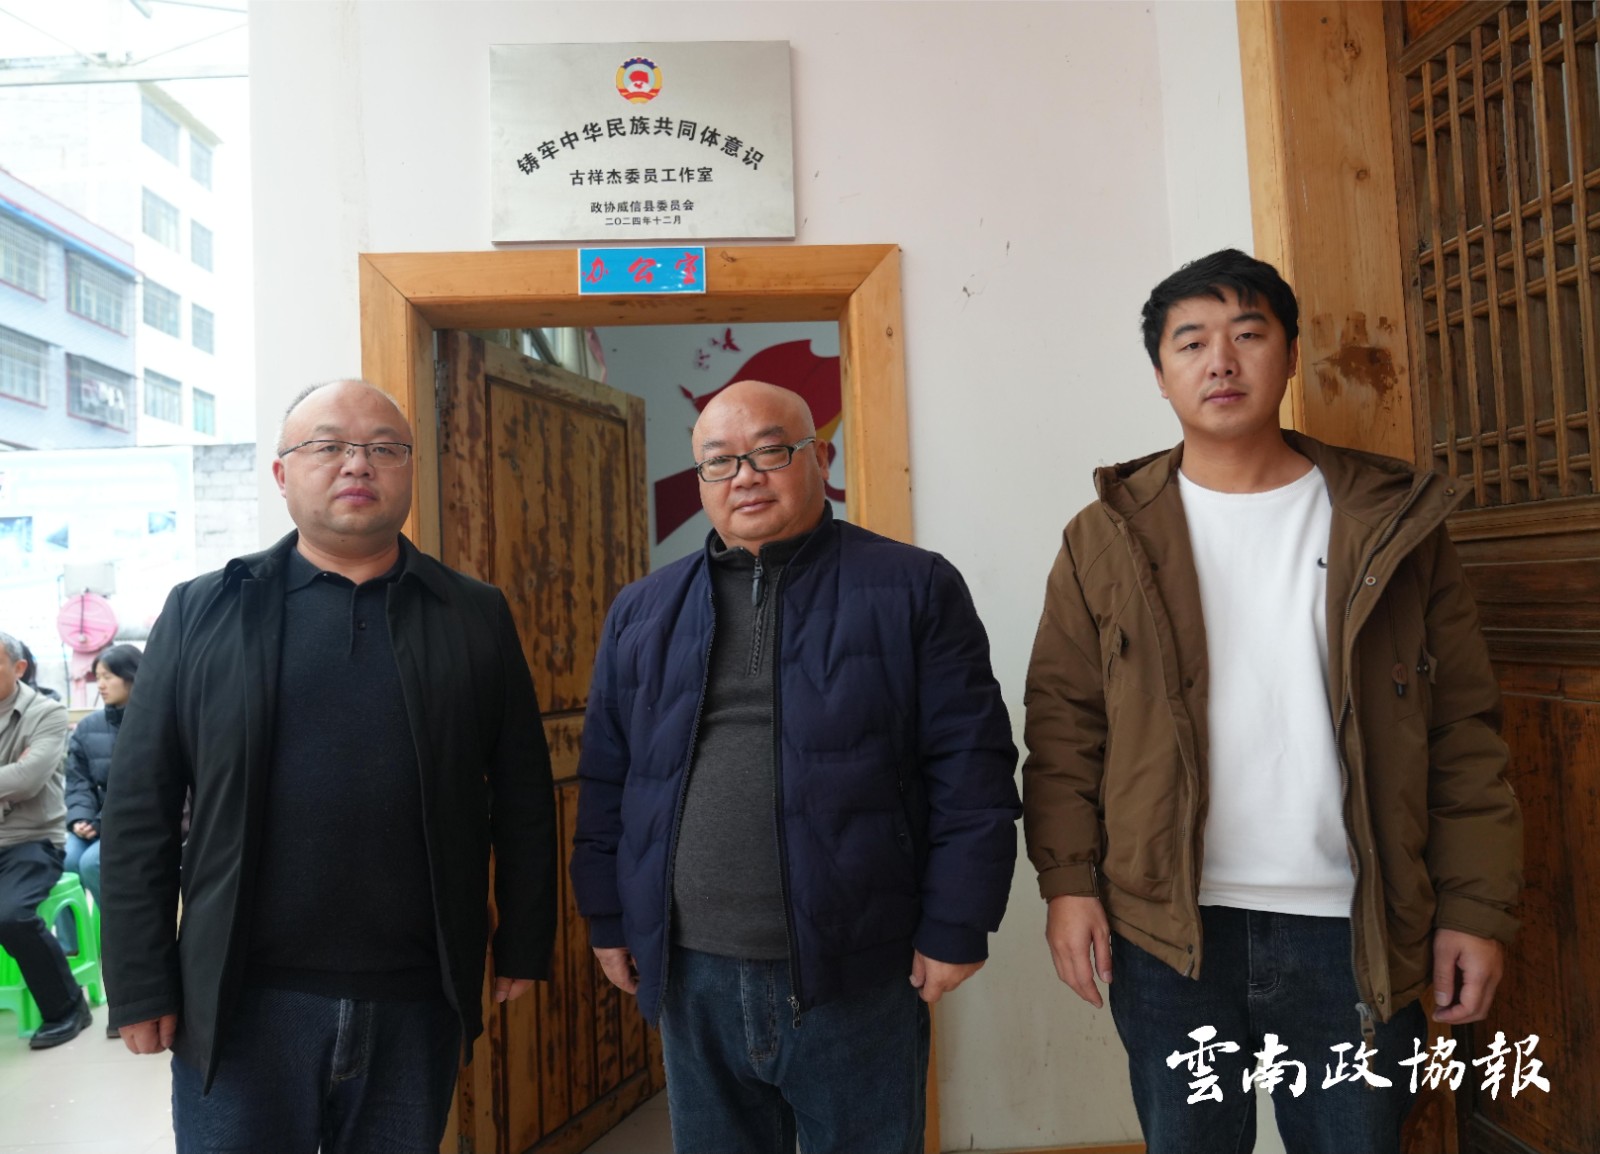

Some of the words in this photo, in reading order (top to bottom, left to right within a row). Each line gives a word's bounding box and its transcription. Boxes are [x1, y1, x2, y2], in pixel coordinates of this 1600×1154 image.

[516, 115, 764, 176] 铸牢中华民族共同体意识
[569, 166, 714, 186] 古祥杰委员工作室
[590, 199, 695, 214] 政协威信县委员会
[581, 252, 700, 285] 办公室
